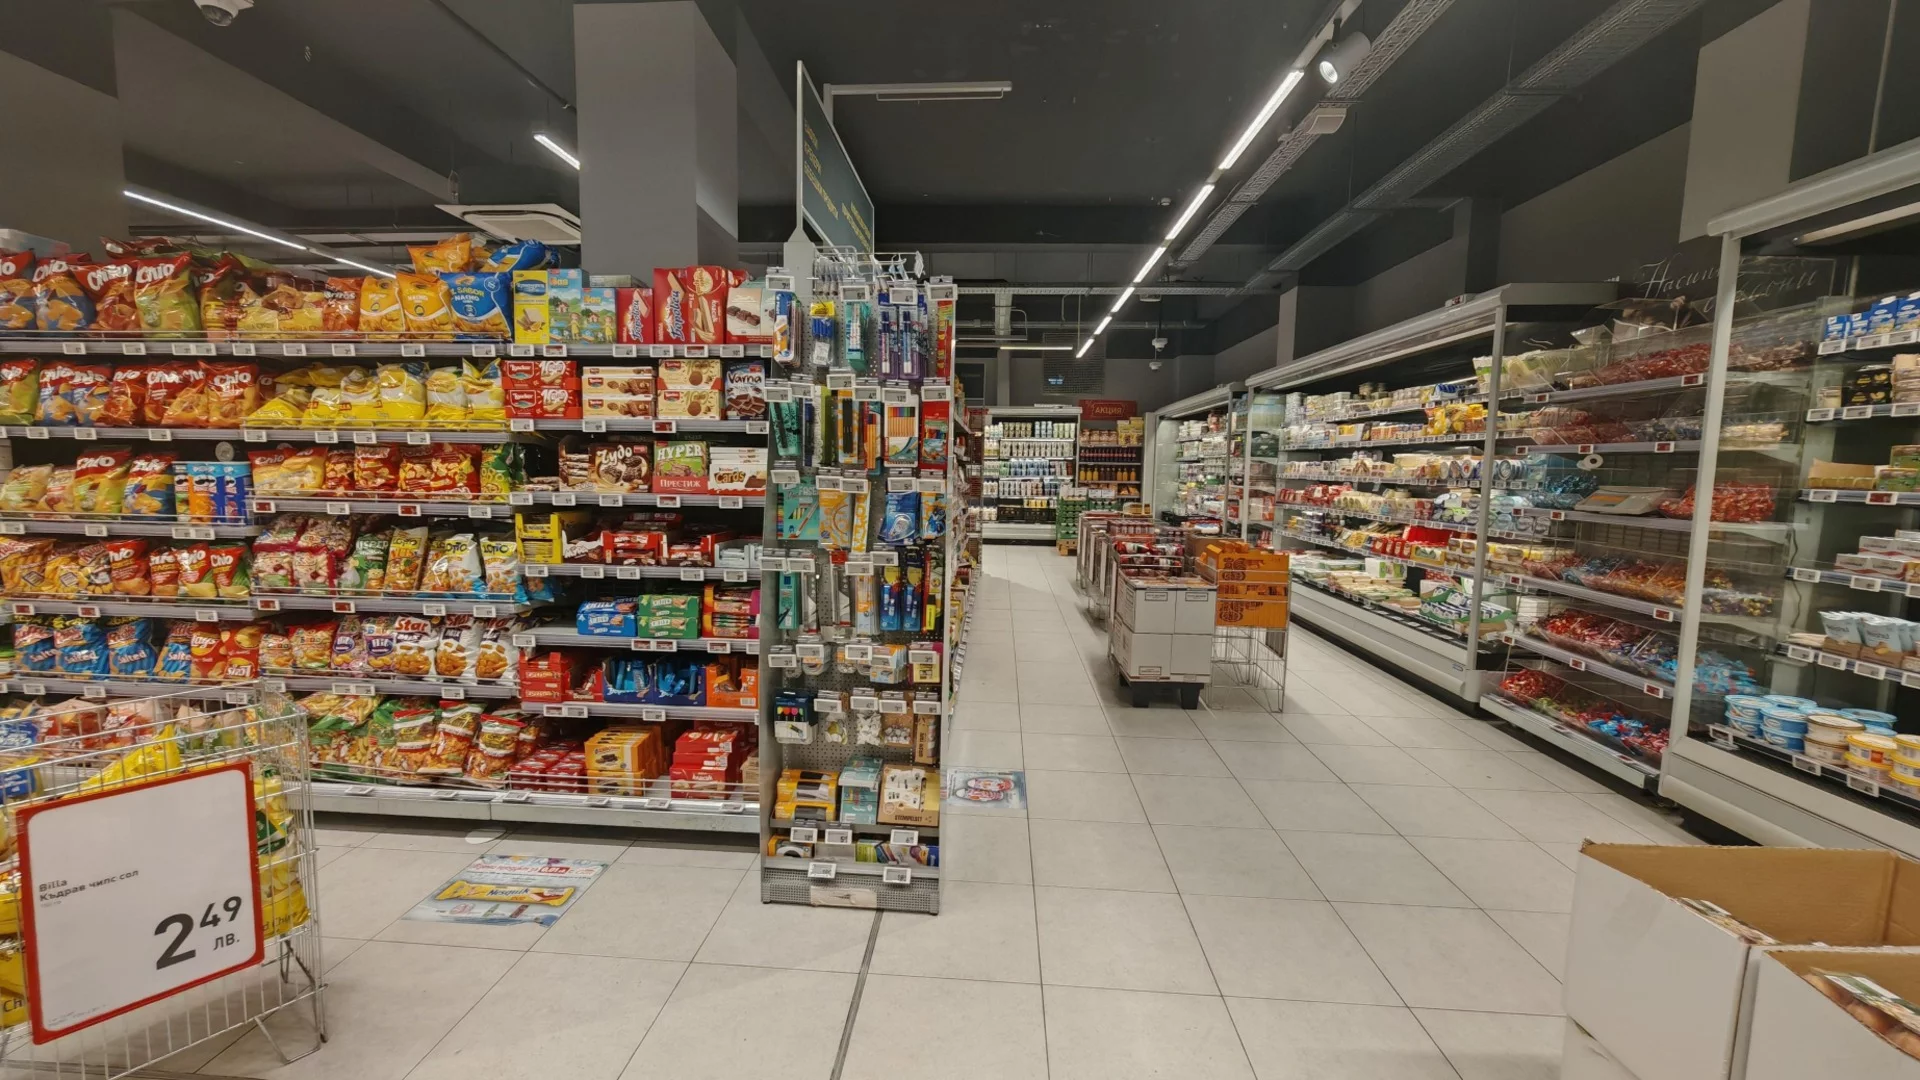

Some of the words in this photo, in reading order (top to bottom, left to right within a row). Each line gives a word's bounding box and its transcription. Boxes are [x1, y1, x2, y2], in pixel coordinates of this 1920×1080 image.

[136, 263, 175, 283] Chio
[728, 371, 762, 385] Varna
[1095, 406, 1123, 415] АКЦИЯ
[657, 443, 703, 460] HYPER
[255, 455, 285, 465] Chio
[660, 479, 702, 488] ПРЕСТИЖ
[715, 470, 746, 484] Cards
[445, 542, 468, 554] OTTO
[395, 615, 428, 632] Star
[38, 879, 68, 893] Billa
[40, 884, 86, 901] Къдрав
[89, 876, 117, 888] чипс
[119, 869, 139, 880] сол
